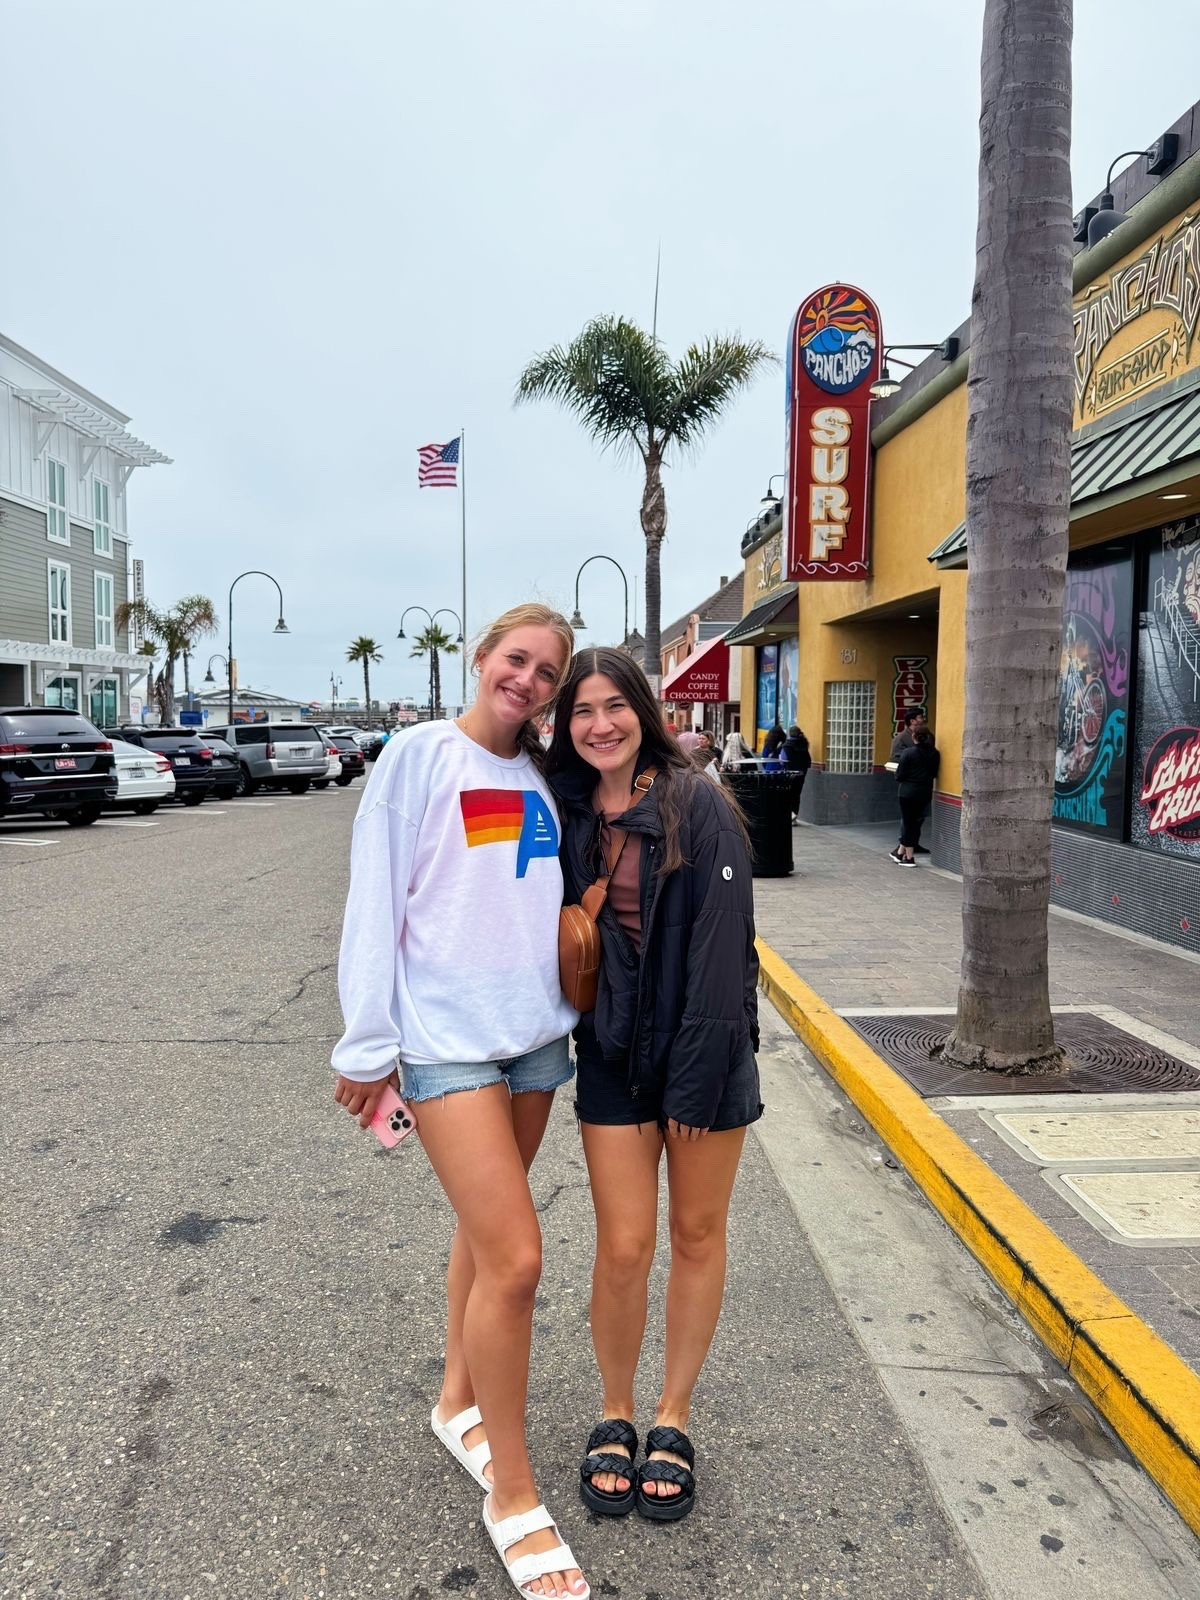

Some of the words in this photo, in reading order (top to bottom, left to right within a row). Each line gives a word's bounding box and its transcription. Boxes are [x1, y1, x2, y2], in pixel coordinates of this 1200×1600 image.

[805, 344, 872, 386] PANCHO'S
[809, 406, 852, 561] SURF
[135, 561, 143, 592] COFFEE
[841, 648, 857, 665] 181
[690, 673, 720, 681] CANDY
